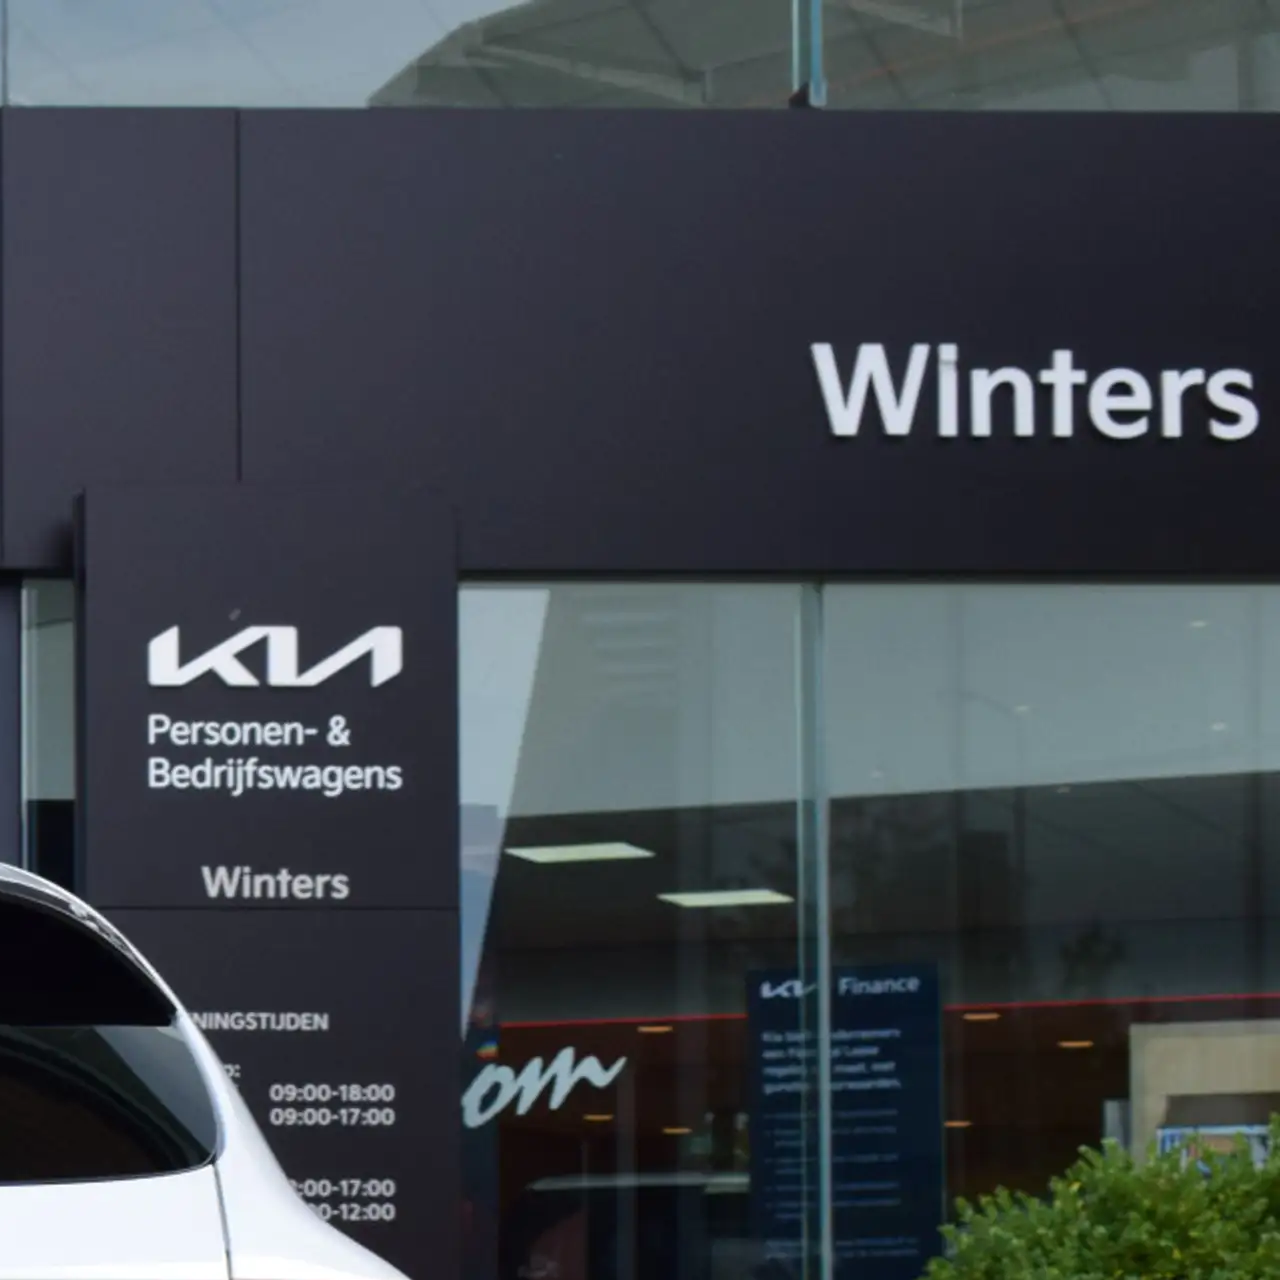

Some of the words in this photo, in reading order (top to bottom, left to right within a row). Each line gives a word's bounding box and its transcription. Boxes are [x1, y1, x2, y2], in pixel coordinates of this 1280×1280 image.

[810, 342, 1260, 440] Winters
[148, 625, 402, 687] KIA
[147, 714, 318, 746] Personen-
[326, 715, 352, 746] &
[147, 757, 403, 797] Bedrijfswagens
[201, 866, 350, 899] Winters
[838, 976, 921, 995] Finance
[187, 1011, 330, 1030] NINGSTIJDEN
[269, 1084, 395, 1102] 09:00-18:00
[269, 1107, 396, 1126] 09:00-17:00
